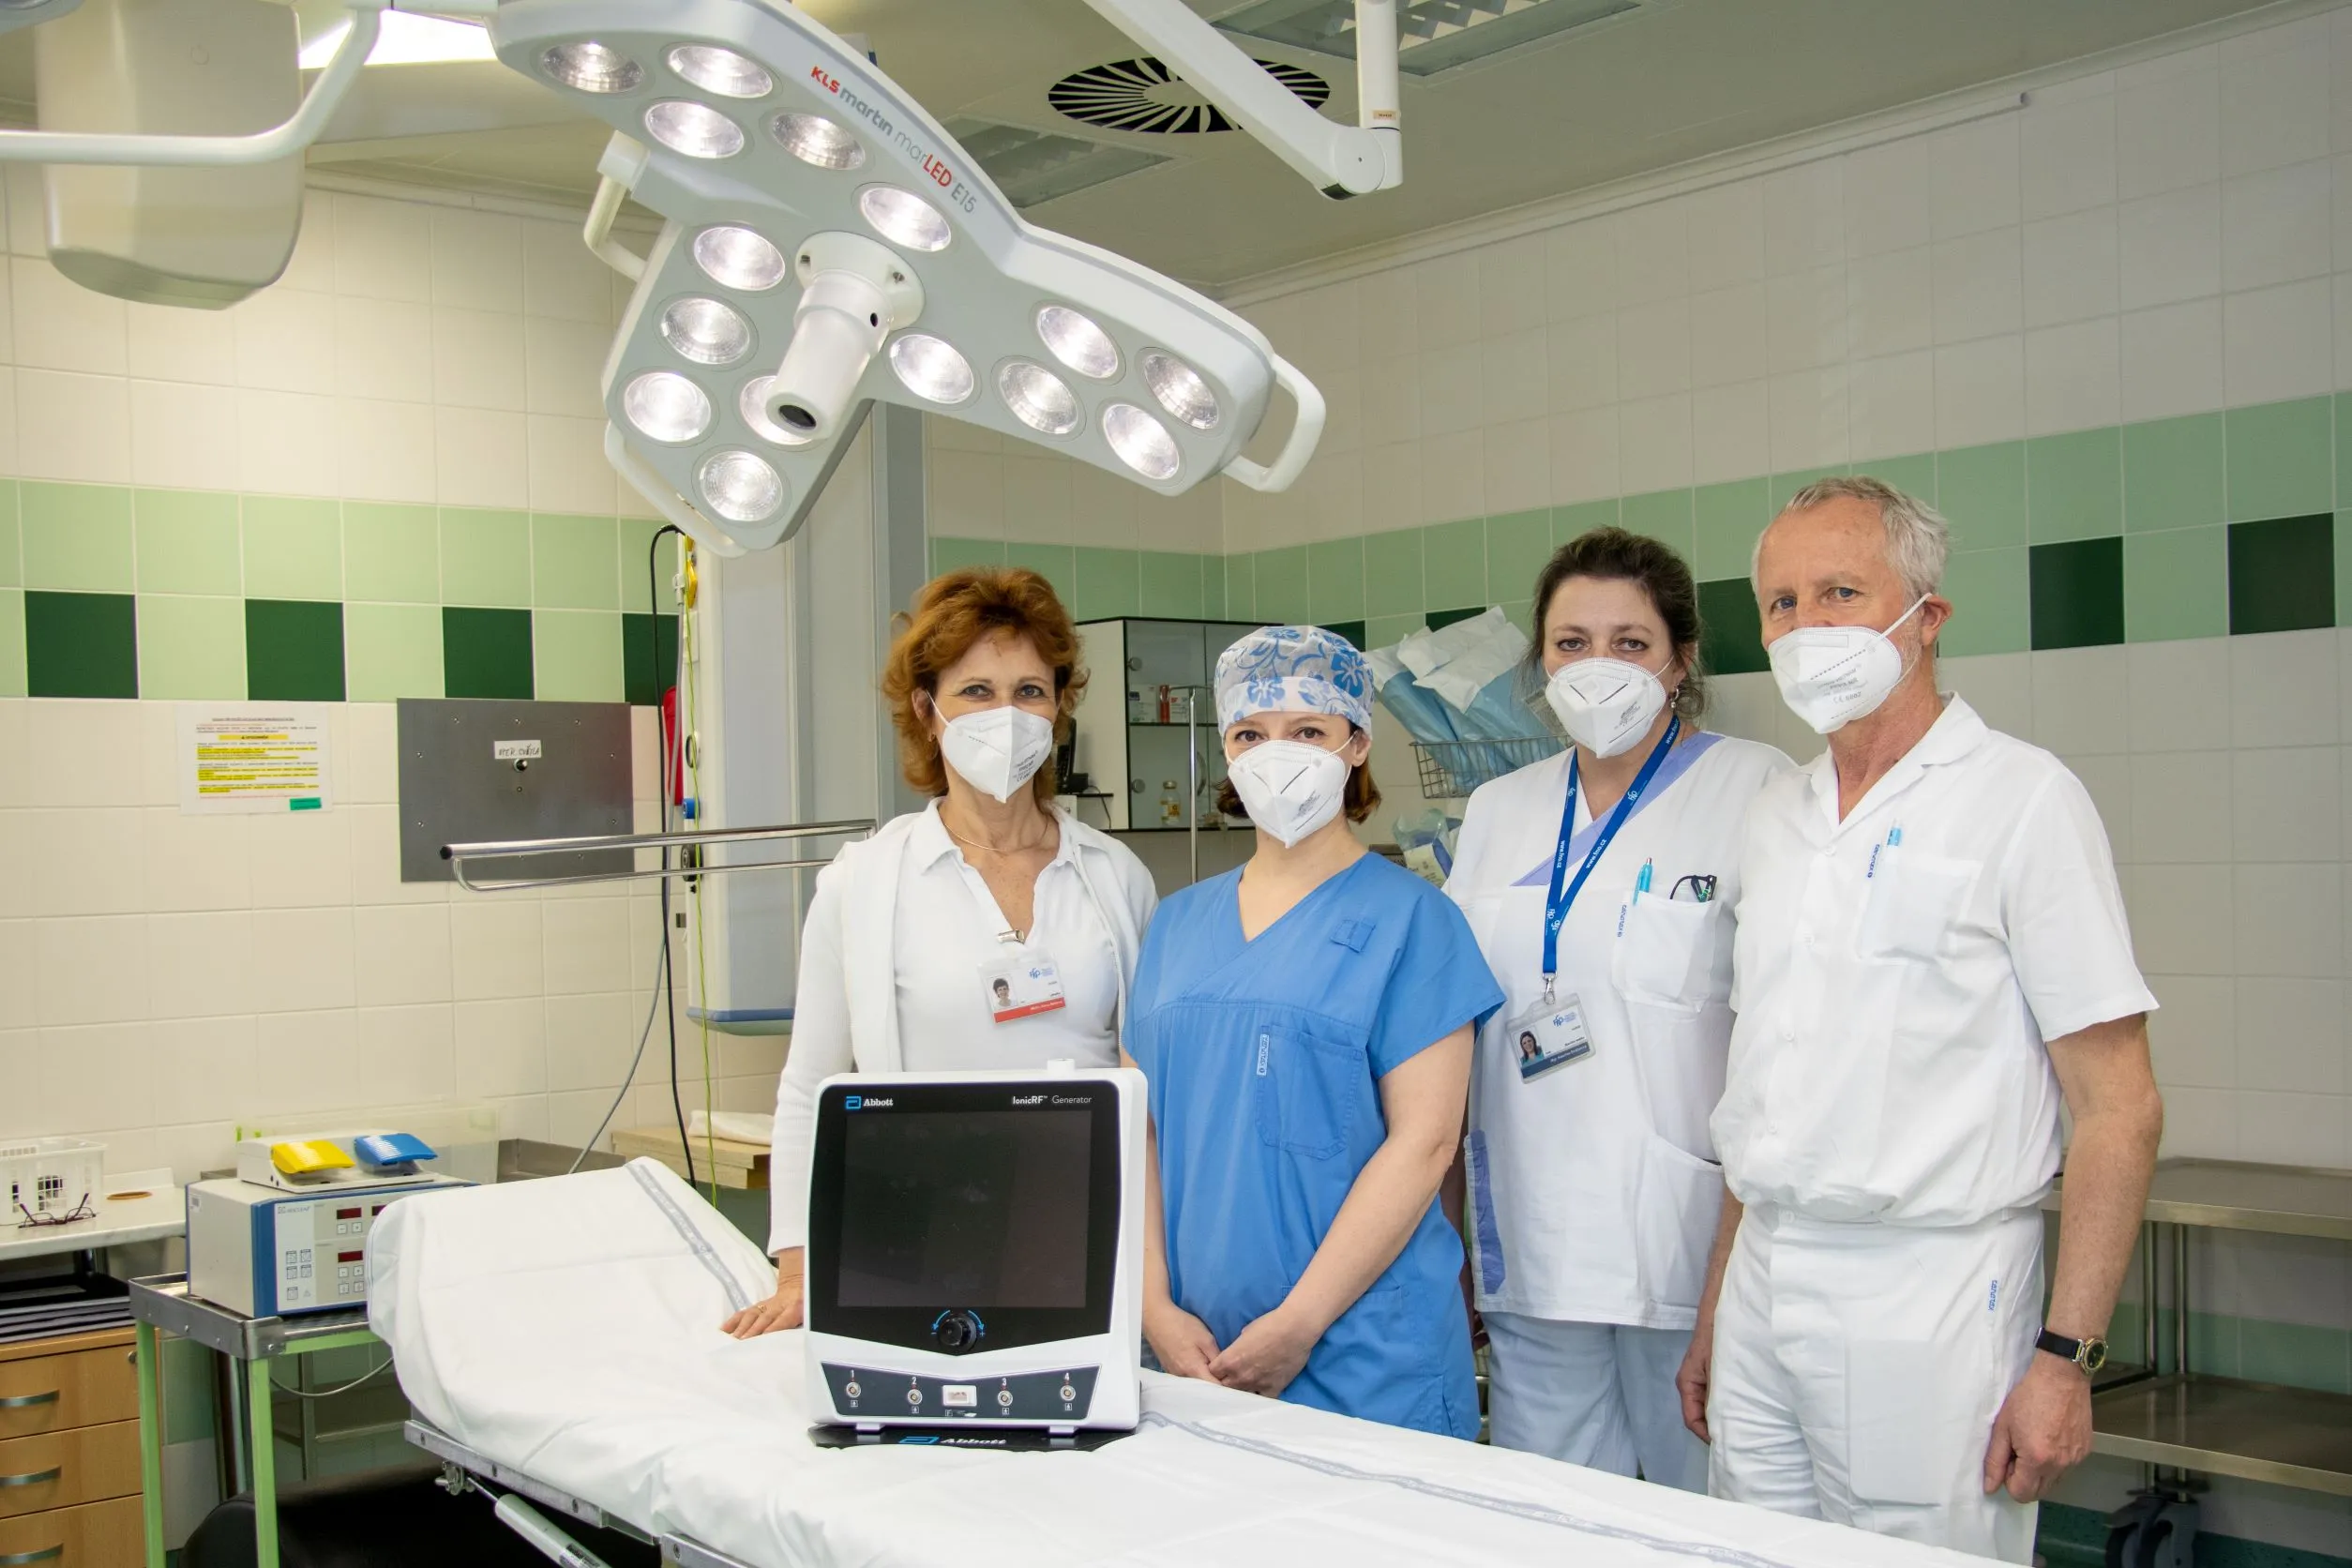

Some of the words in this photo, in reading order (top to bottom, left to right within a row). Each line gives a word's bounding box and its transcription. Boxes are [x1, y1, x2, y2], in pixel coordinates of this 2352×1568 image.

[810, 66, 840, 94] KLS
[839, 86, 894, 136] martin
[894, 131, 952, 188] marLED
[950, 183, 977, 214] E15
[1557, 839, 1566, 869] www.fno.cz
[1585, 838, 1606, 869] www.fno.cz
[863, 1097, 894, 1107] Abbott
[1051, 1094, 1093, 1104] Generator
[912, 1376, 917, 1385] 2
[1002, 1377, 1007, 1386] 3
[1064, 1372, 1070, 1381] 4
